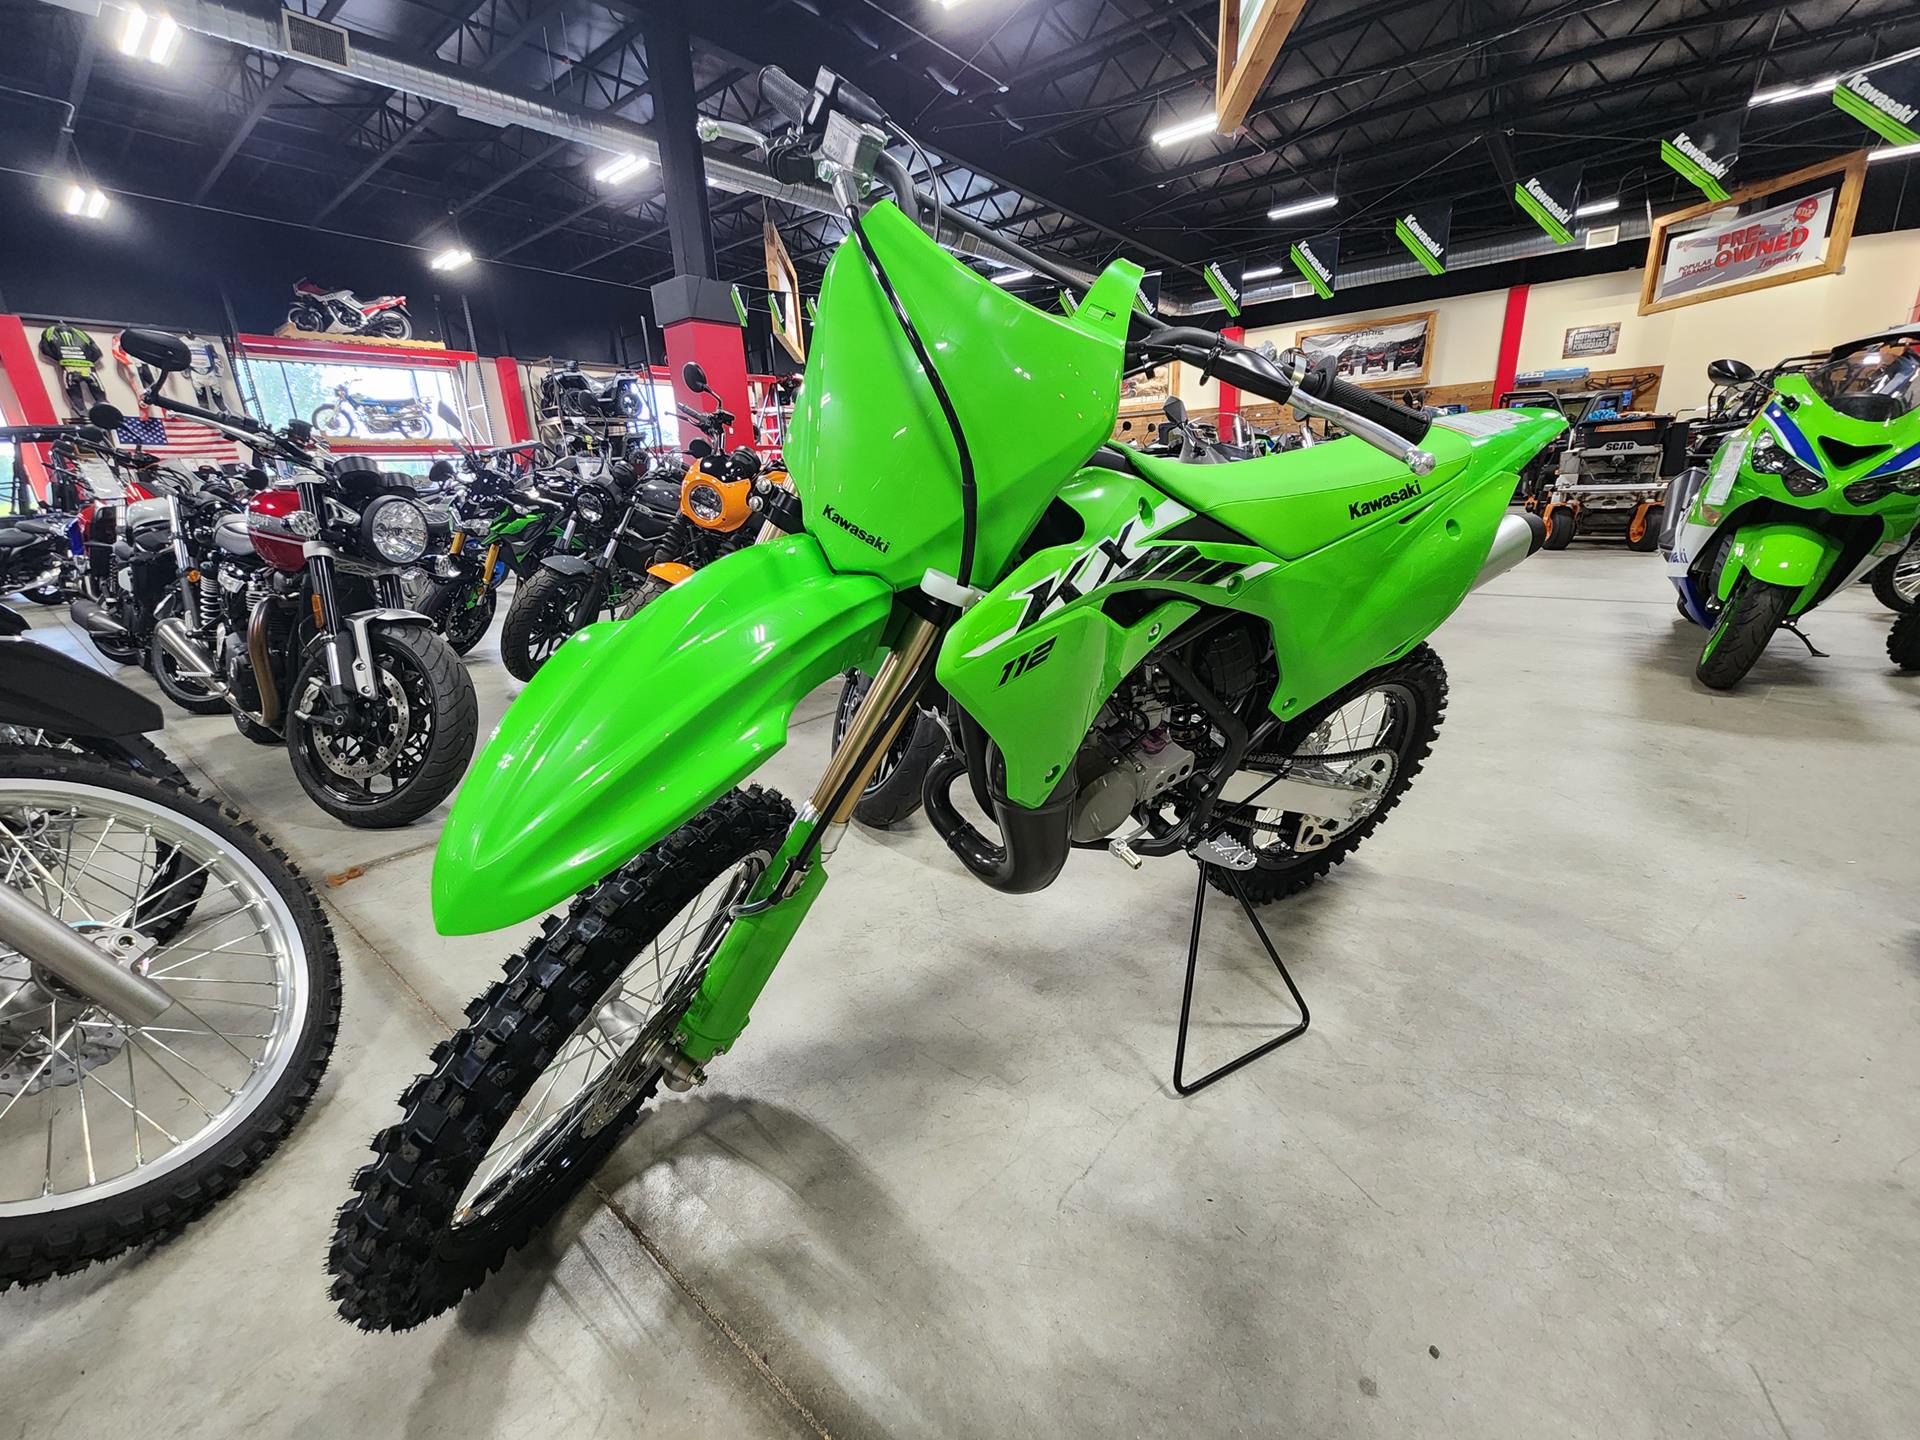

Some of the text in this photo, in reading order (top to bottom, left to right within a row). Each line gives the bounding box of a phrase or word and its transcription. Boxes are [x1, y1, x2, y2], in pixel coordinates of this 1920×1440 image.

[1846, 72, 1919, 124] Kawasaki
[1672, 132, 1729, 180] Kawasaki
[1524, 177, 1574, 225] Kawasaki
[1403, 213, 1444, 258] Kawasaki
[1714, 227, 1809, 268] OWNED
[1717, 223, 1767, 251] PRE-
[1210, 261, 1240, 301] Kawasaki
[1298, 240, 1333, 283] Kawasaki
[1679, 258, 1712, 272] POPULAR
[1682, 266, 1712, 278] BRANDS
[1341, 329, 1385, 341] POLARIS
[1605, 441, 1634, 451] SCAG
[1348, 480, 1422, 520] Kawasaki
[822, 504, 891, 554] Kawasaki
[1015, 519, 1135, 635] KX
[998, 635, 1058, 687] 112
